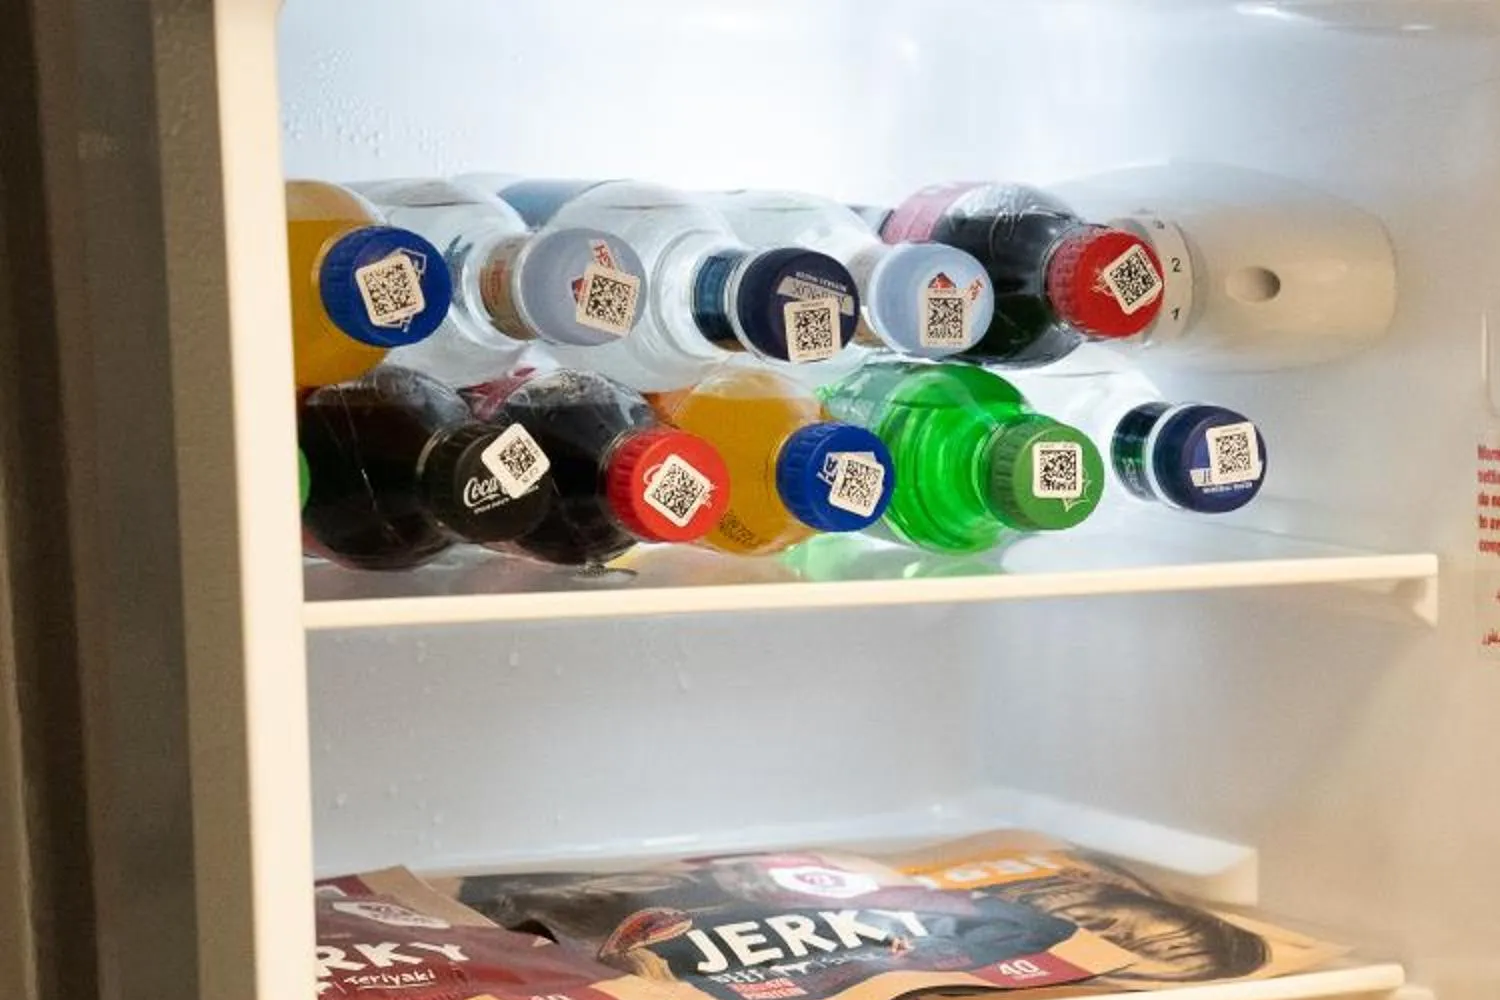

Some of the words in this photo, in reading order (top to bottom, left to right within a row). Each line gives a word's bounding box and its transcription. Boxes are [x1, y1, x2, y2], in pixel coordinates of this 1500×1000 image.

[1171, 257, 1182, 273] 2
[1171, 307, 1181, 321] 1
[1478, 492, 1490, 506] do
[1479, 515, 1489, 528] to
[697, 908, 931, 974] JERKY
[317, 941, 470, 978] RKY
[344, 967, 437, 991] Teriyaki
